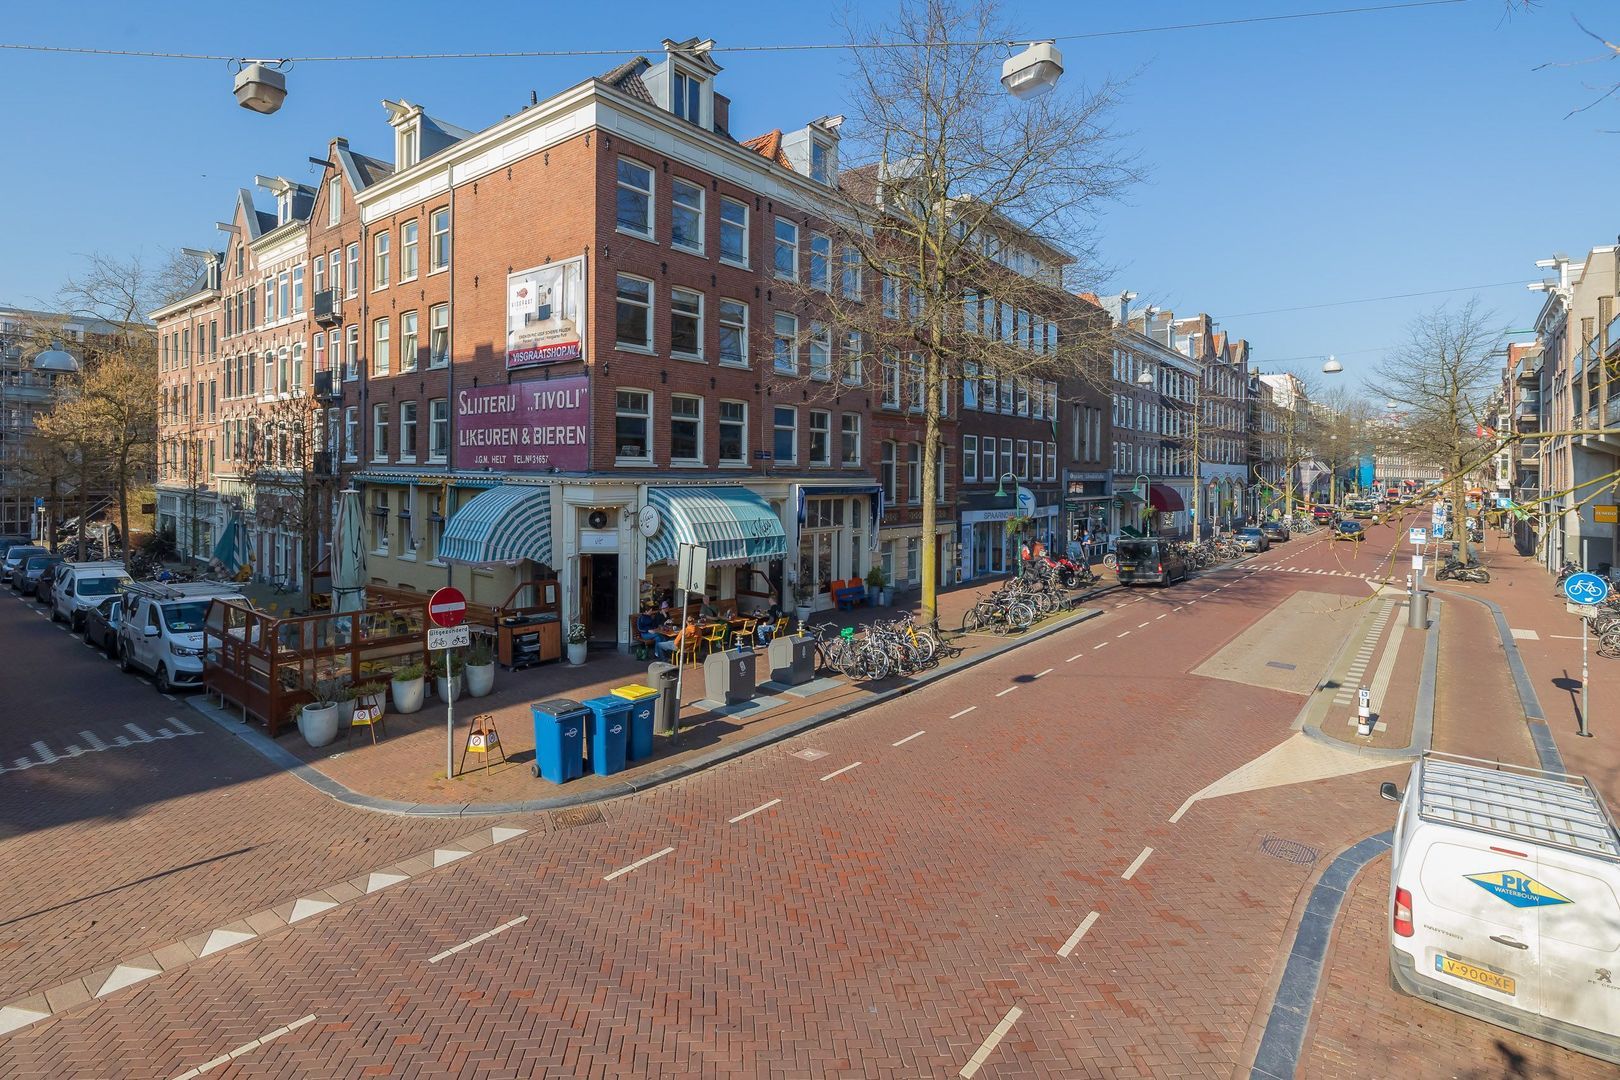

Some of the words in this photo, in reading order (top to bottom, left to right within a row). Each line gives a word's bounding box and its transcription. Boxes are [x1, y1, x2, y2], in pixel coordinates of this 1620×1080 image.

[512, 345, 576, 362] VISGRAATSHOP.NL
[460, 427, 518, 447] LIKEUREN
[521, 427, 531, 445] &
[533, 425, 586, 445] BIEREN
[491, 455, 507, 464] HELT
[1502, 874, 1532, 895] PK
[1494, 886, 1540, 901] WATERBOUW
